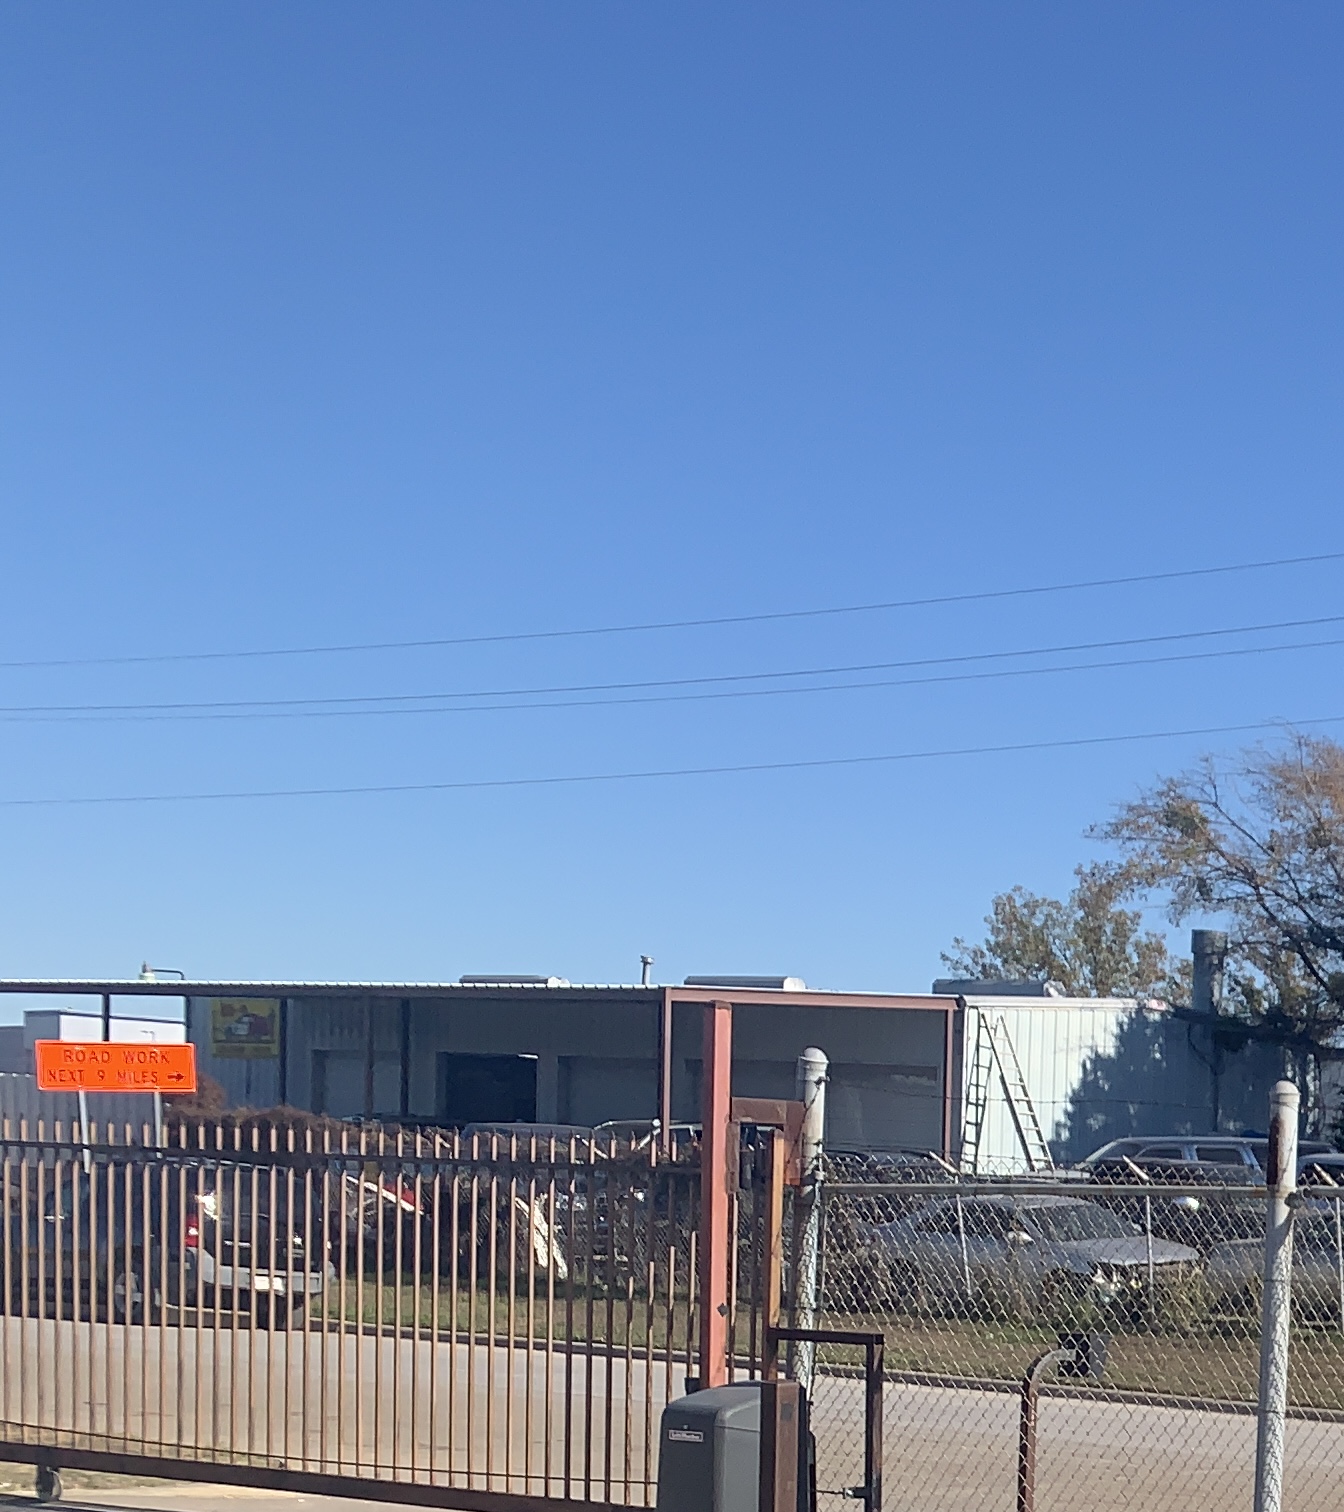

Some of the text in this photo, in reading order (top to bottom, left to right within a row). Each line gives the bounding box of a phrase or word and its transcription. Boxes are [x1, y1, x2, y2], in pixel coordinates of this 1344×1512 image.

[63, 1049, 171, 1064] ROAD WORK
[47, 1069, 158, 1084] NEXT 9 MILES
